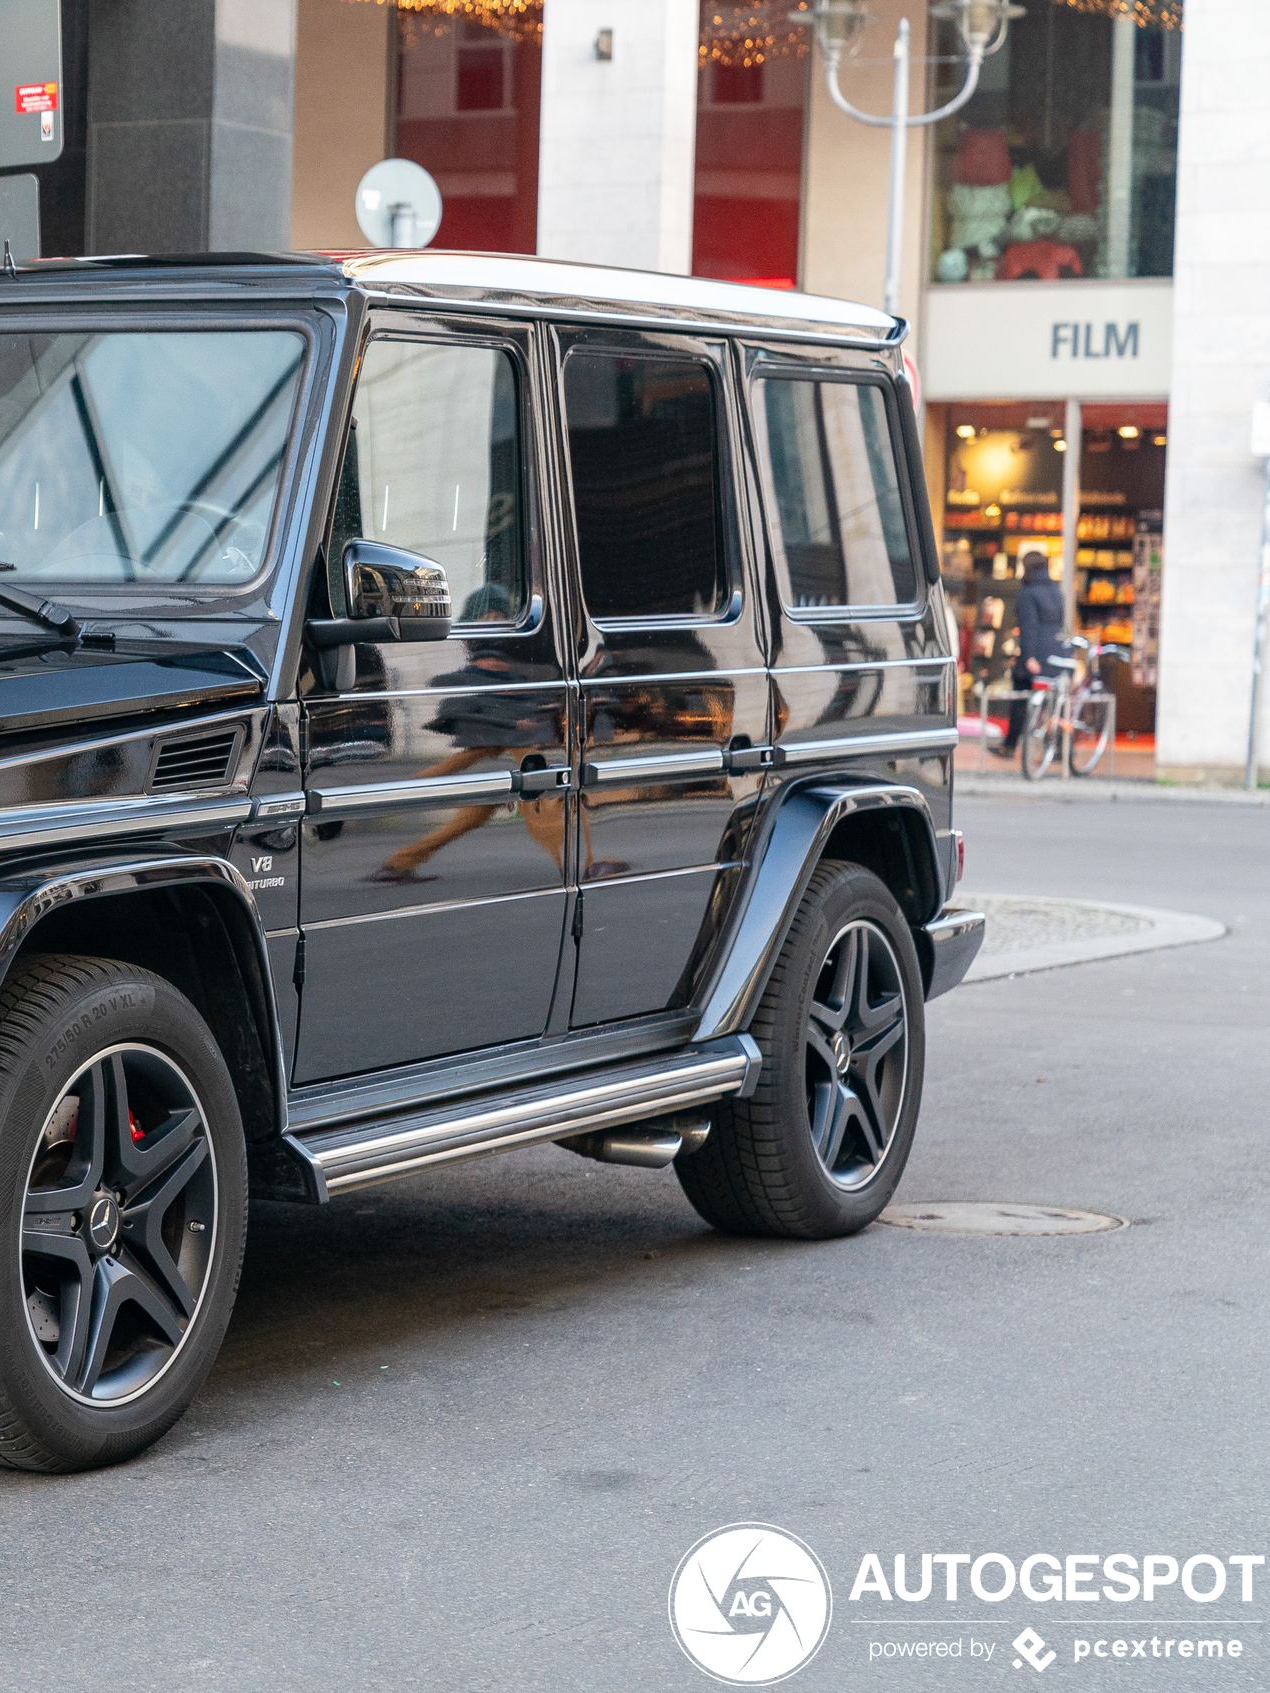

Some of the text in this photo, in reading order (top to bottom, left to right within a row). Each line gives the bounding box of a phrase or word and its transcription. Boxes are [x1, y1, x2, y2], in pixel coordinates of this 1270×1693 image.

[1052, 323, 1139, 357] FILM
[250, 856, 273, 873] V8
[45, 1023, 81, 1070] 275/50
[80, 1014, 92, 1028] R
[92, 1003, 108, 1021] 20
[108, 997, 119, 1012] V
[119, 993, 136, 1008] XL
